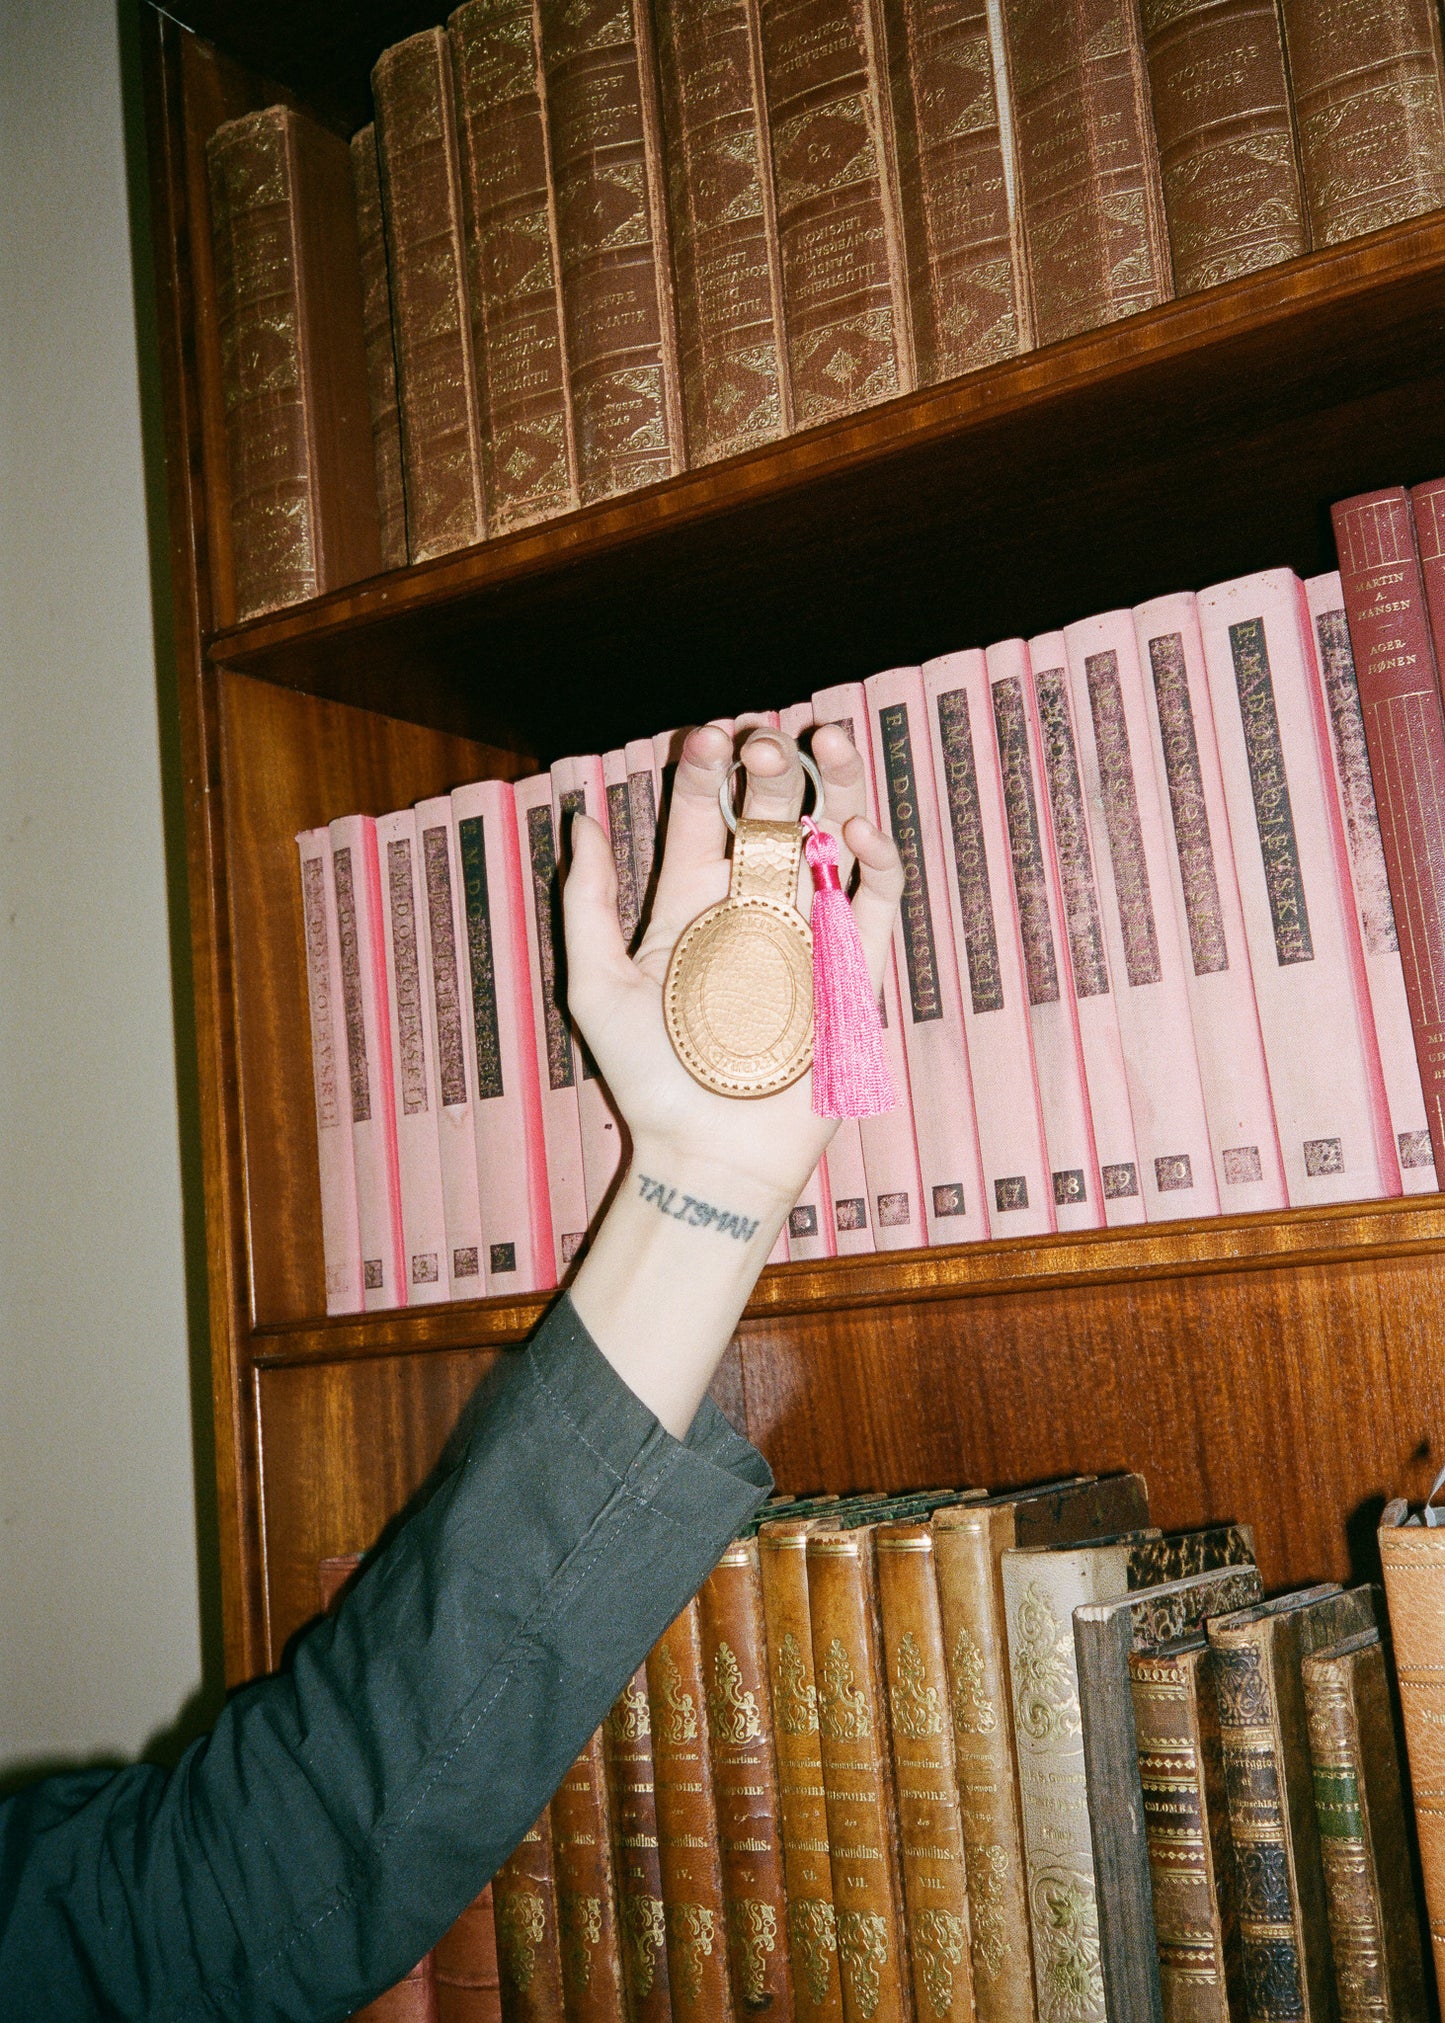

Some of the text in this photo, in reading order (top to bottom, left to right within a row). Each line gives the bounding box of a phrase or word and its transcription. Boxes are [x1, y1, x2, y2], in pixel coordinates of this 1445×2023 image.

[1355, 572, 1405, 593] MARTIN
[1358, 599, 1412, 621] HANSEN
[1367, 653, 1418, 675] HØNEN
[1247, 691, 1304, 954] DOSTOJEVSKIJ
[894, 775, 938, 1014] DOSTOJEVSKIJ
[951, 763, 999, 1008] DOSTOJEVSKIJ
[395, 901, 423, 1107] DOSTOJEVSKIJ
[1058, 1177, 1080, 1196] 18
[1108, 1170, 1131, 1190] 19
[638, 1173, 760, 1243] TALISMAN
[827, 1789, 876, 1803] HISTOIRE
[899, 1788, 948, 1802] HISTOIRE
[847, 1876, 869, 1889] VII.
[919, 1876, 945, 1889] VIII.
